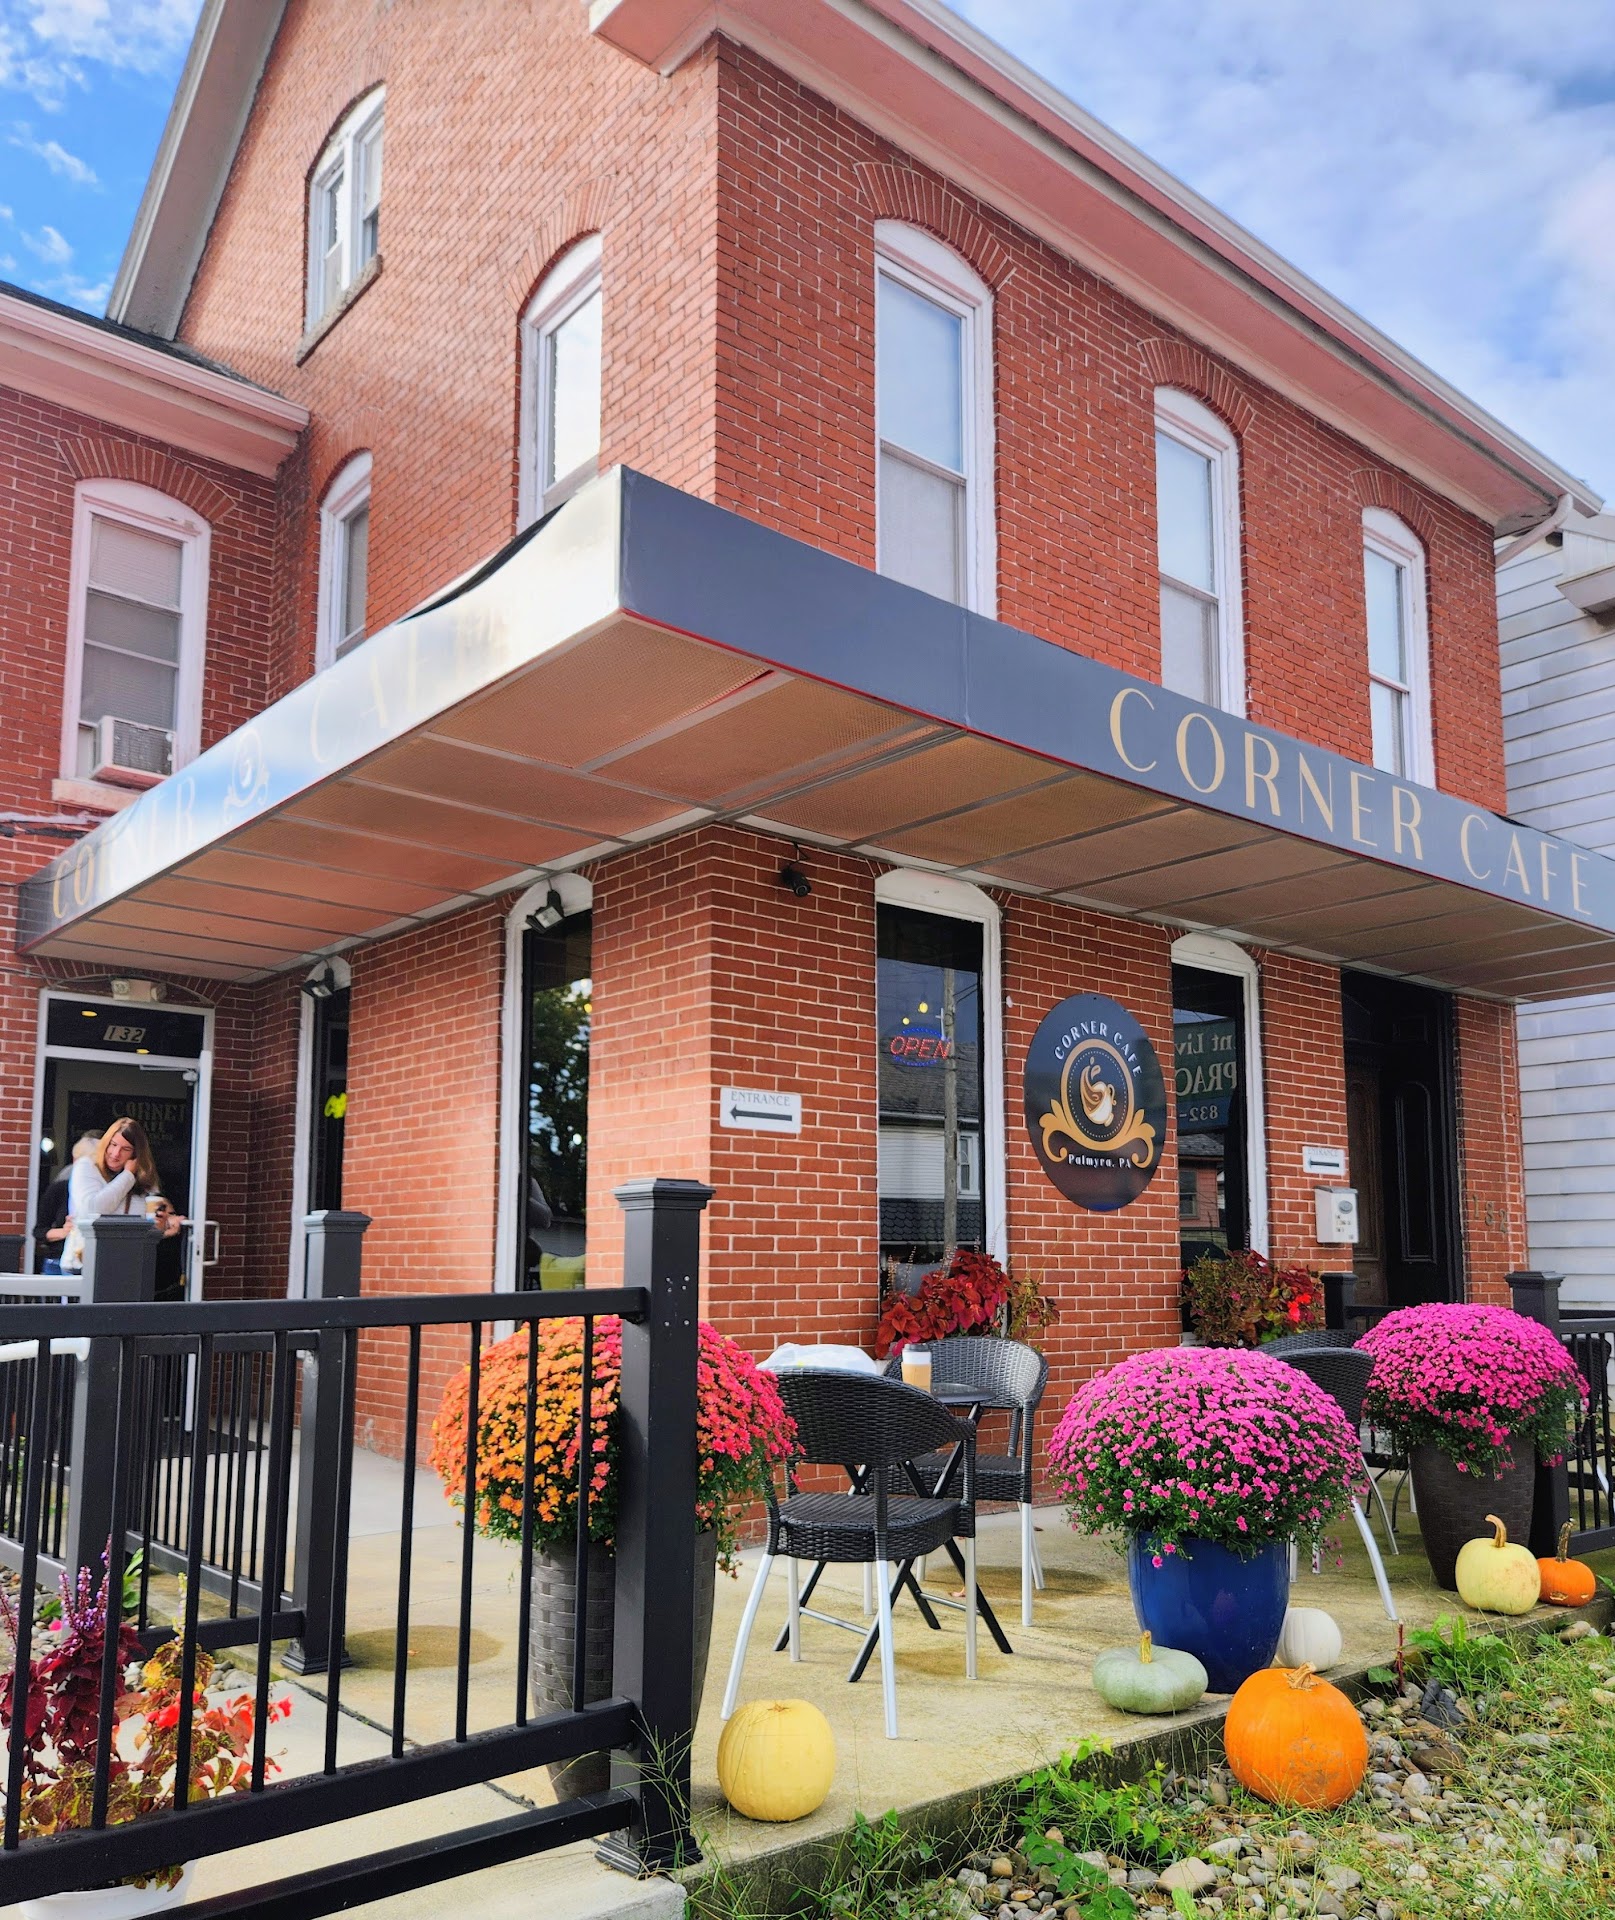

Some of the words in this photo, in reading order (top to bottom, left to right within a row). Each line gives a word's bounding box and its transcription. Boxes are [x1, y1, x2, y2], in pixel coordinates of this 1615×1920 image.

[1108, 687, 1425, 861] CORNER
[1459, 813, 1593, 916] CAFE
[108, 1026, 143, 1042] 132
[890, 1035, 952, 1059] OPEN
[1054, 1020, 1108, 1060] CORNER
[1113, 1031, 1143, 1077] CAFE
[731, 1090, 791, 1107] ENTRANCE
[1118, 1157, 1132, 1169] PA
